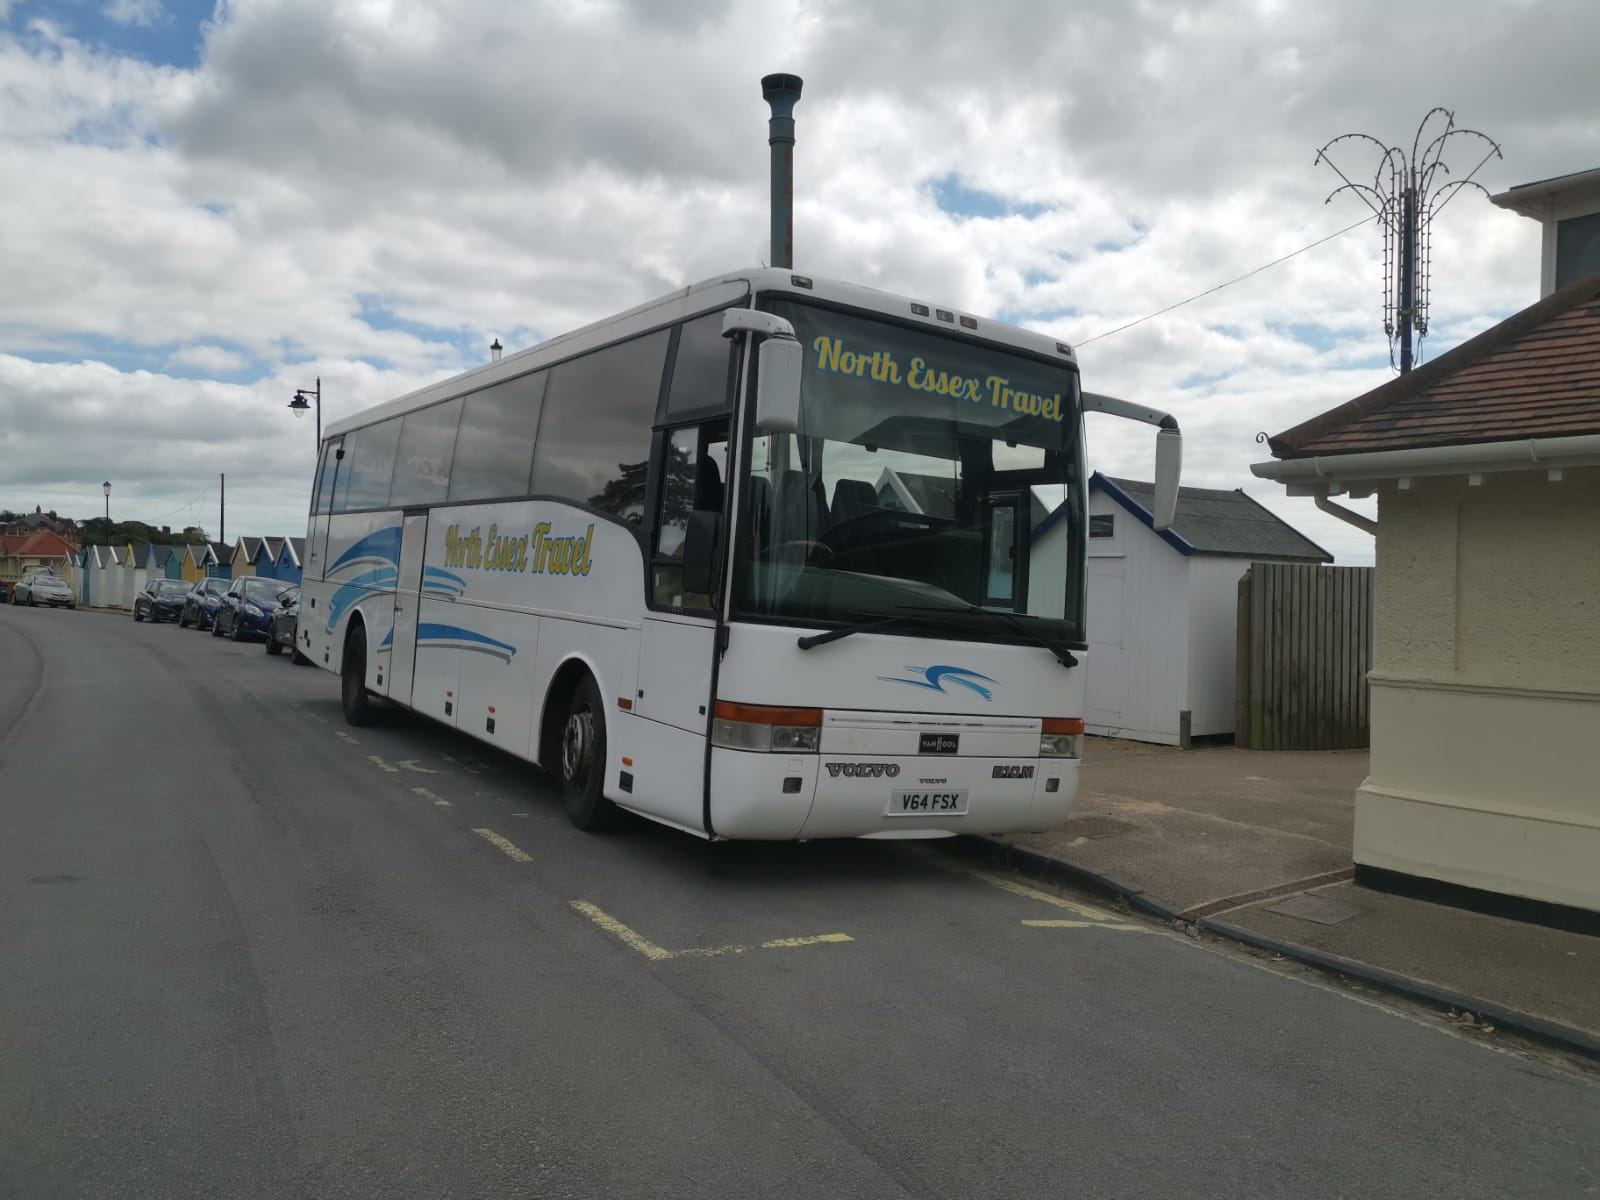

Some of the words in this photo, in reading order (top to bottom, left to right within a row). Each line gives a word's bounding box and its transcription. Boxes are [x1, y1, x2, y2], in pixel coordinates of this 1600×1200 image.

[814, 336, 901, 384] North
[907, 358, 982, 402] Essex
[986, 375, 1064, 422] Travel
[444, 524, 482, 568] North
[483, 523, 528, 572] Essex
[532, 521, 594, 576] Travel
[825, 762, 901, 778] VOLVO
[903, 794, 929, 810] V64
[931, 794, 959, 810] FSX
